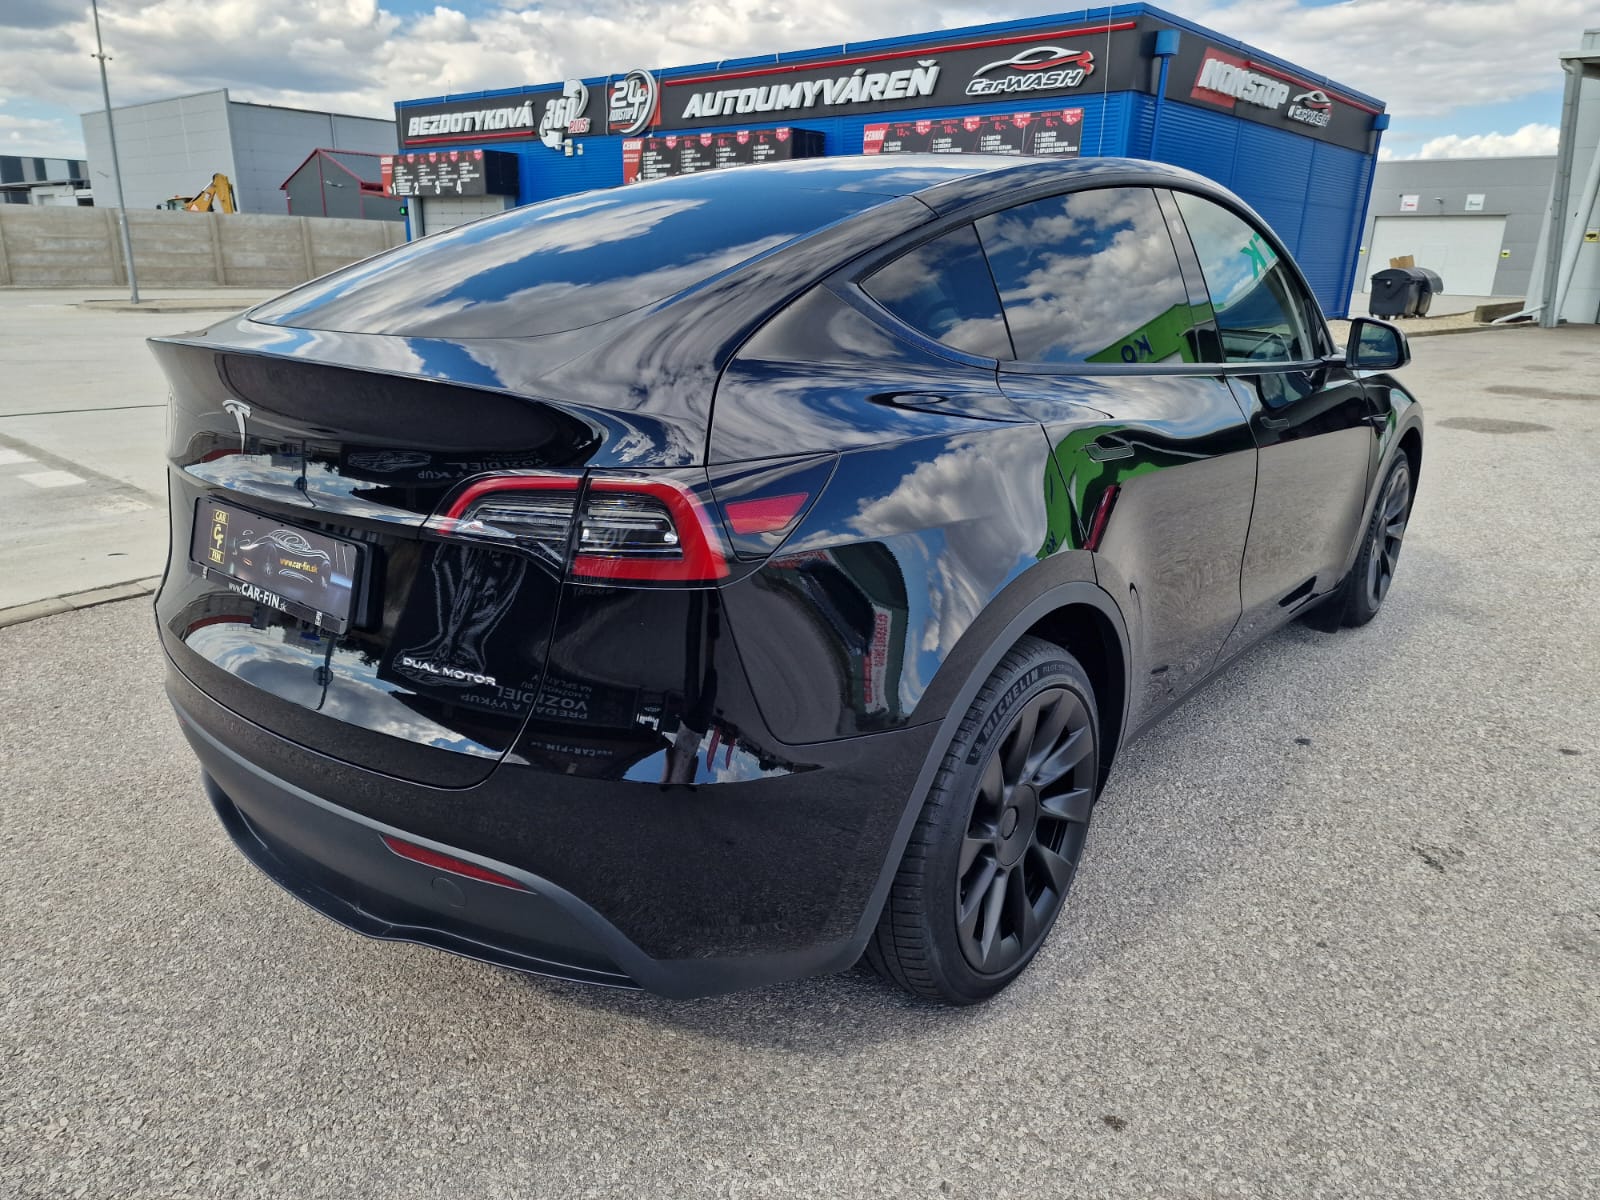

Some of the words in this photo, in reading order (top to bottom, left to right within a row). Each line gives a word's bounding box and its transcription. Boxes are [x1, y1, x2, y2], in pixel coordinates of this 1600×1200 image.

[682, 59, 941, 119] AUTOUMYVÁREŇ
[1198, 58, 1290, 110] NONSTOP
[408, 100, 535, 137] BEZDOTYKOVÁ
[543, 98, 578, 130] 360
[215, 511, 226, 524] CAR
[402, 657, 439, 674] DUAL
[442, 666, 497, 686] MOTOR
[983, 668, 1040, 740] MICHELIN
